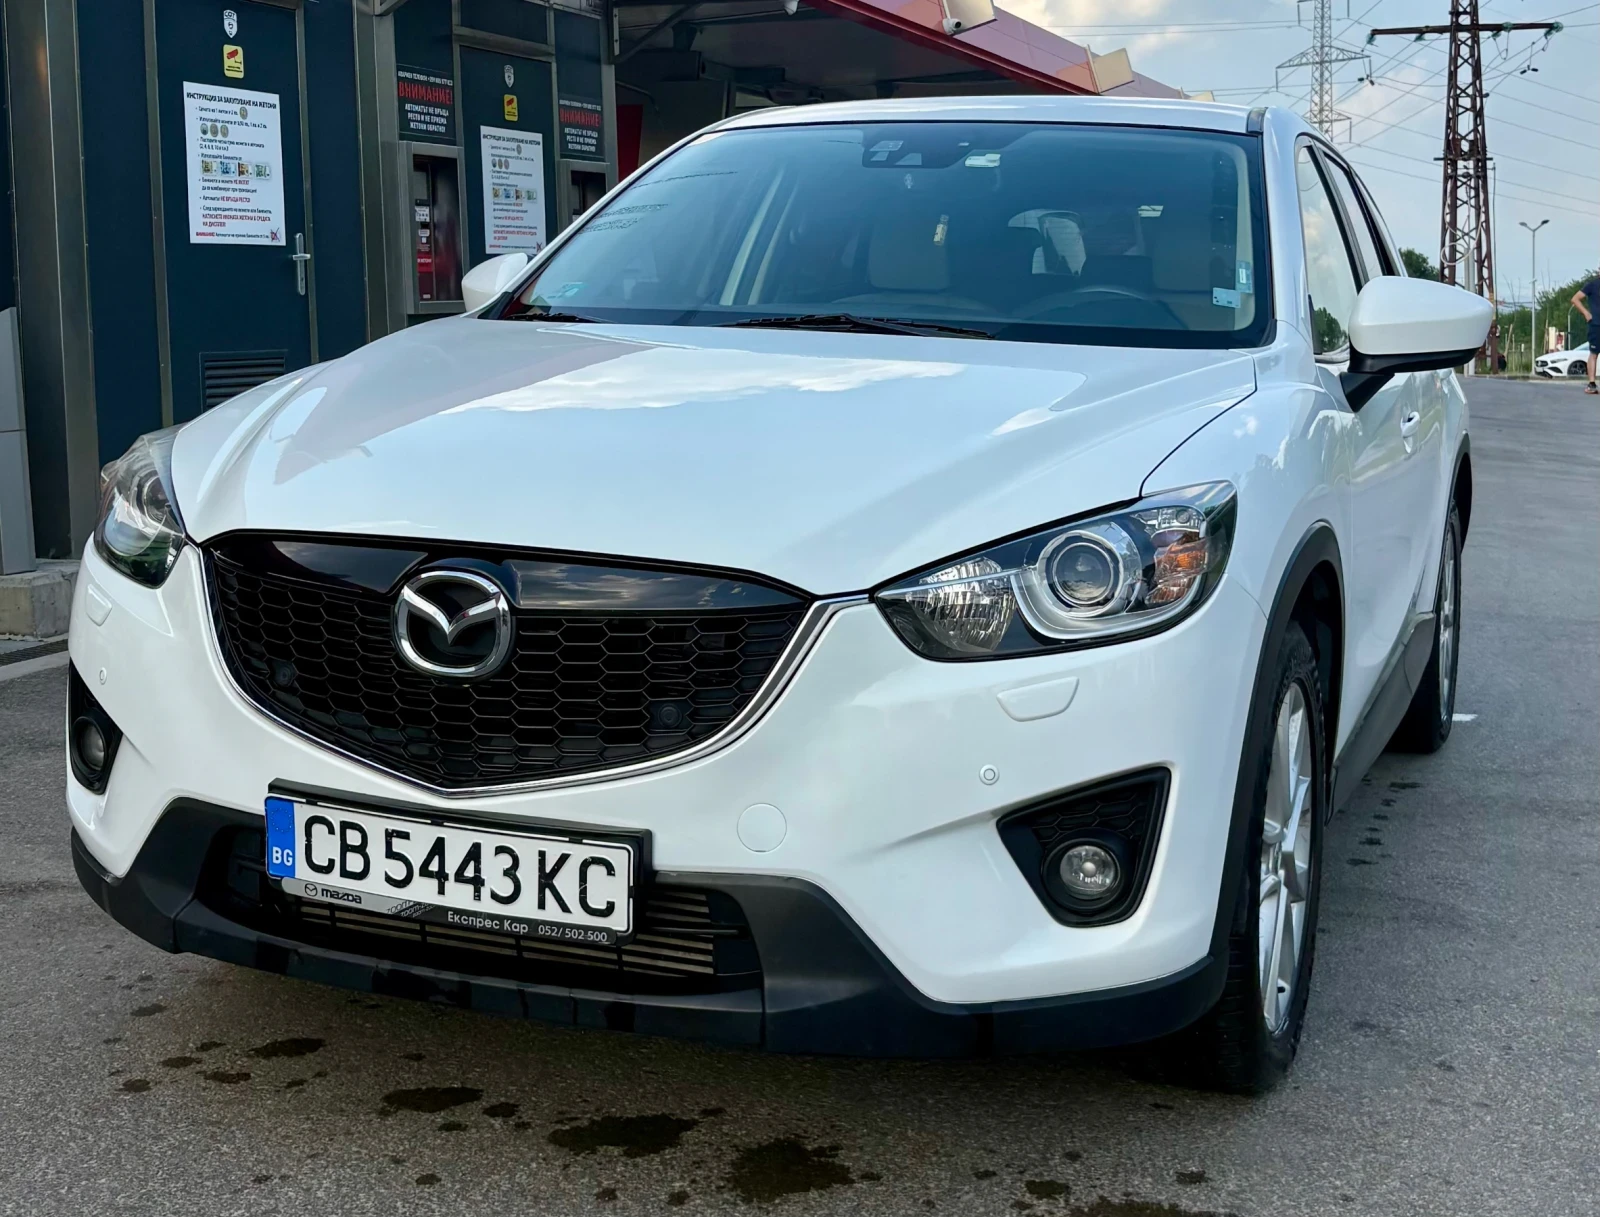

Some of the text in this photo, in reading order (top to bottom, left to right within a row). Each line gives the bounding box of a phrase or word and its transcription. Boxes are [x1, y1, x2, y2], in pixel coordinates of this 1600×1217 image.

[398, 82, 453, 104] ВНИМАНИЕ!
[405, 103, 449, 116] АВТОМАТЪТ НЕ ВРЪЩА
[408, 113, 420, 121] РЕСТО
[431, 116, 447, 124] ПРИЕМА
[272, 846, 293, 867] BG
[304, 814, 616, 918] CB 5443 KC
[321, 888, 362, 904] mazda
[447, 911, 500, 930] Експрес
[504, 919, 528, 935] Кар
[565, 928, 584, 940] 502
[587, 930, 608, 942] 500
